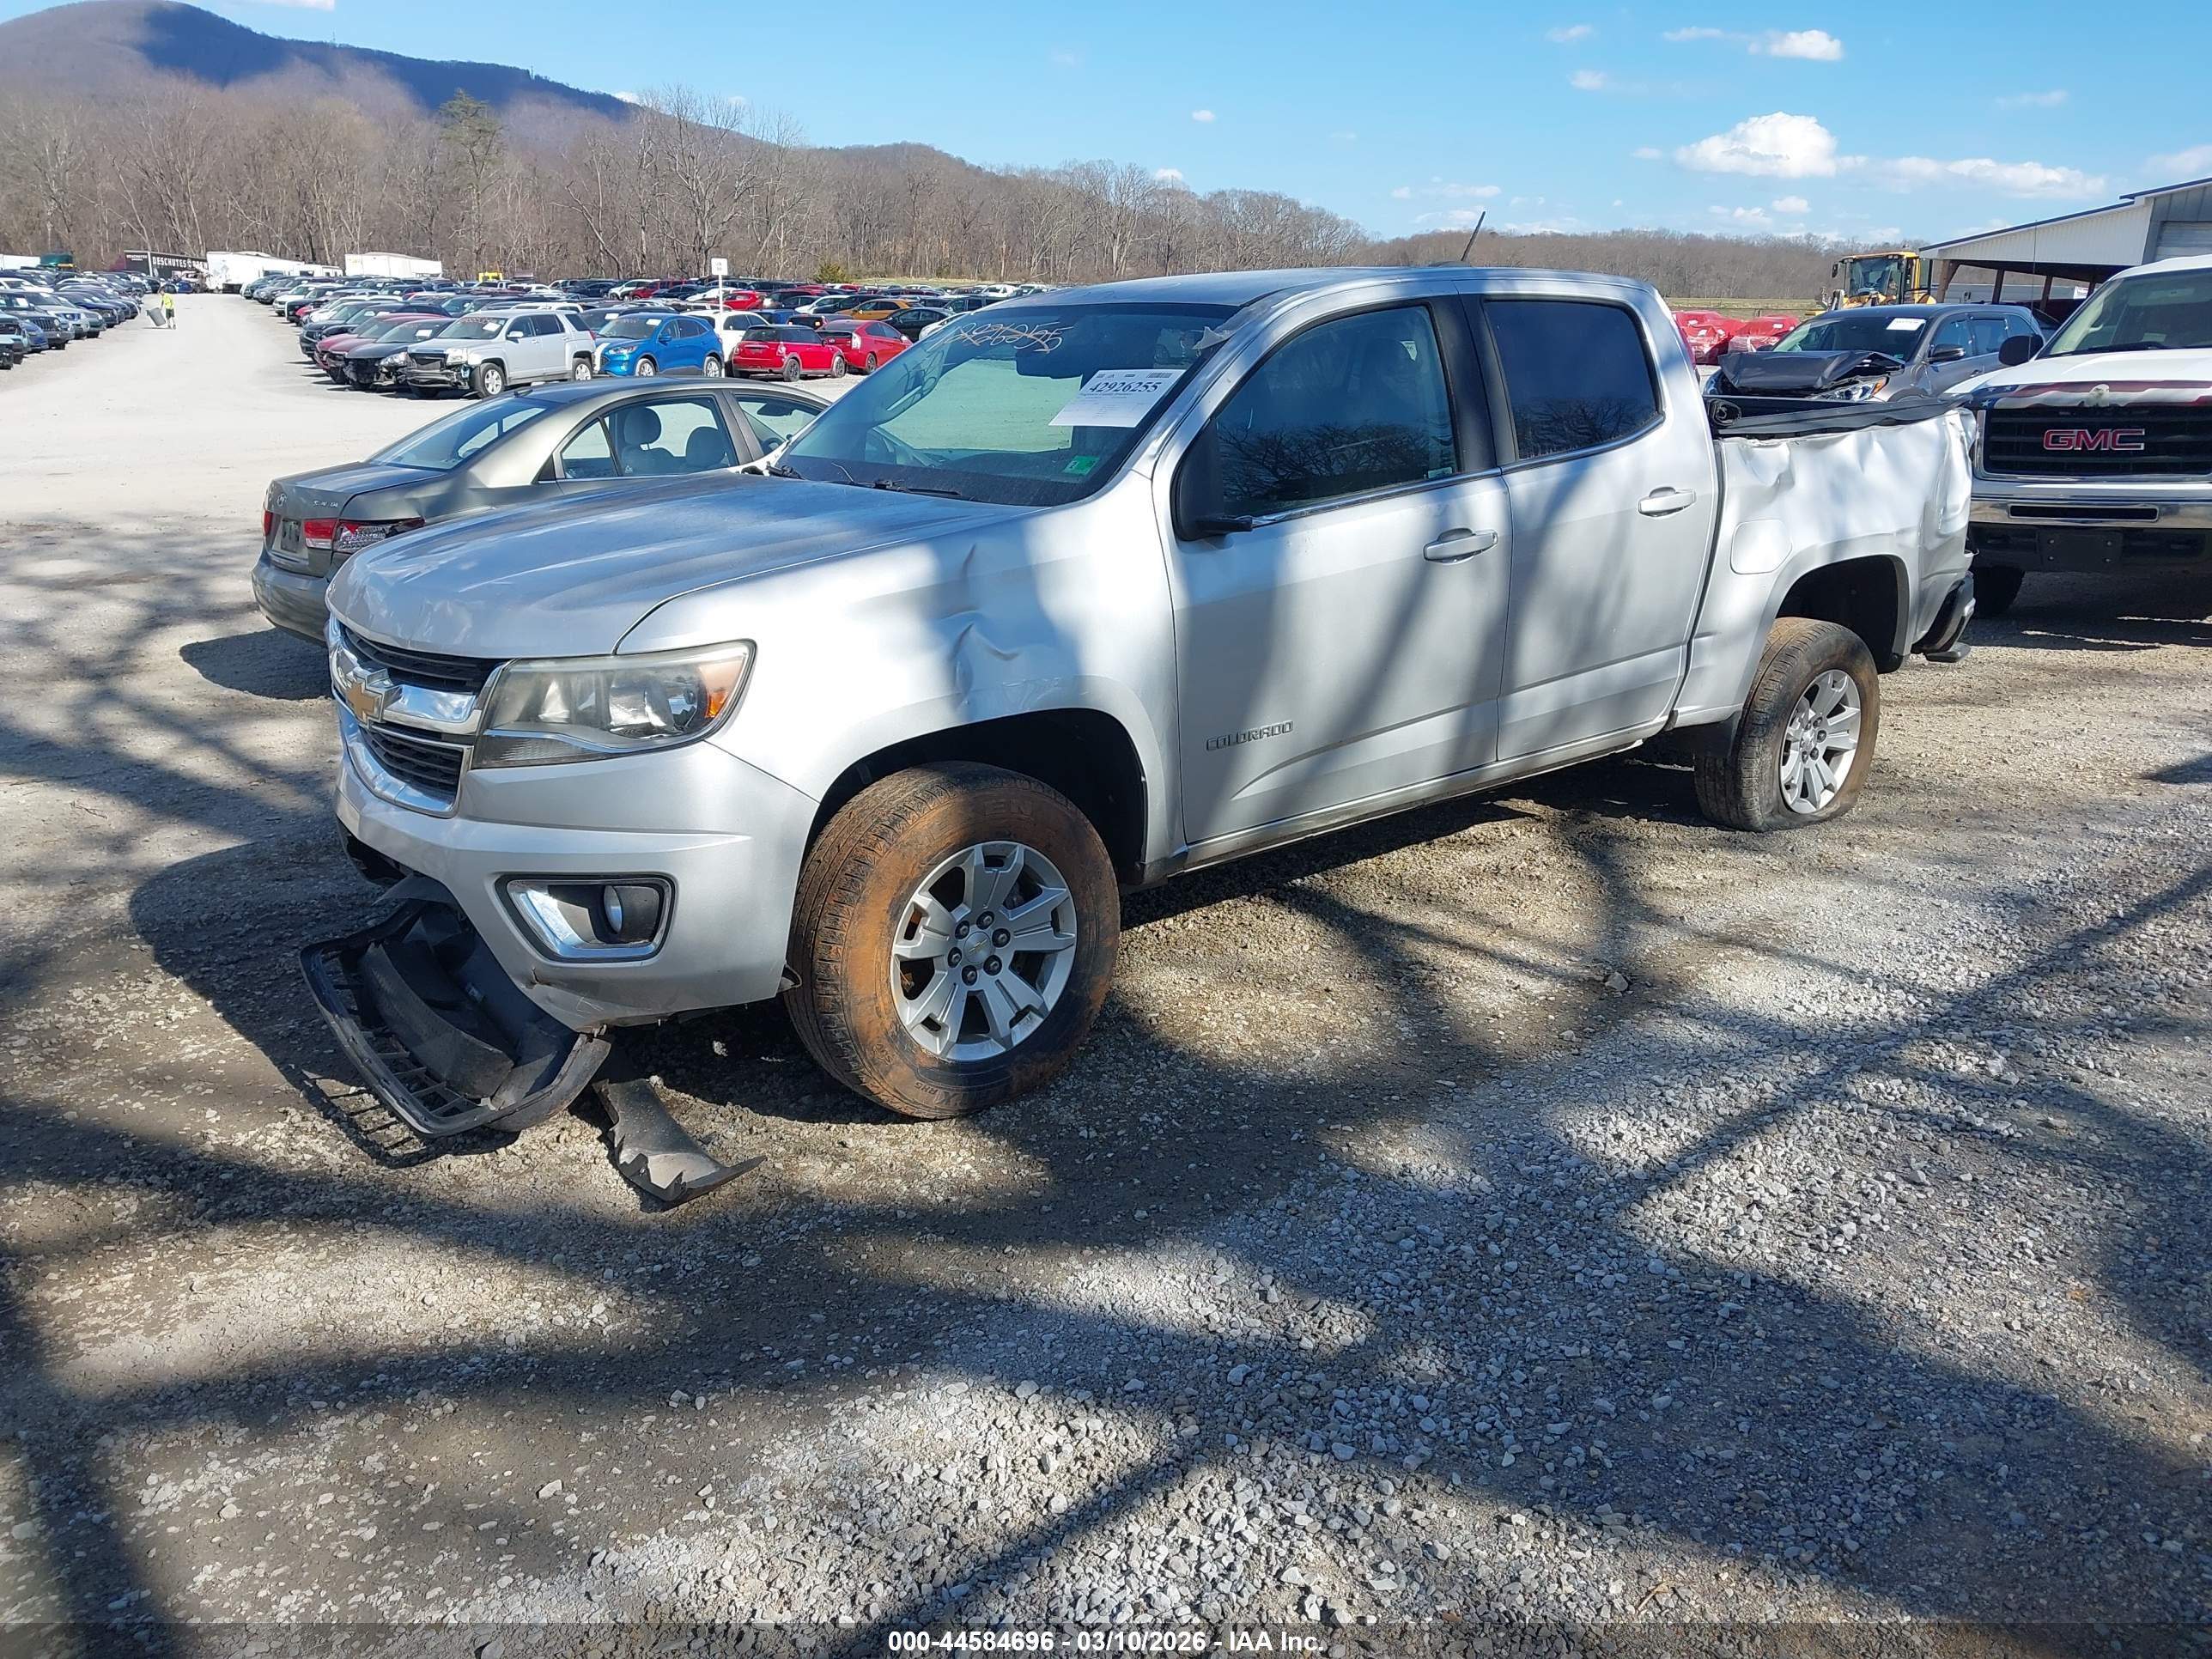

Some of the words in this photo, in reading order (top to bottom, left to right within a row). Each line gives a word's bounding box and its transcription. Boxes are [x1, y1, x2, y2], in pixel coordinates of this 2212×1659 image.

[152, 256, 186, 268] DESCHUTES
[1089, 381, 1162, 392] 42926255
[2043, 428, 2145, 451] GMC
[1206, 720, 1294, 751] COLORADO
